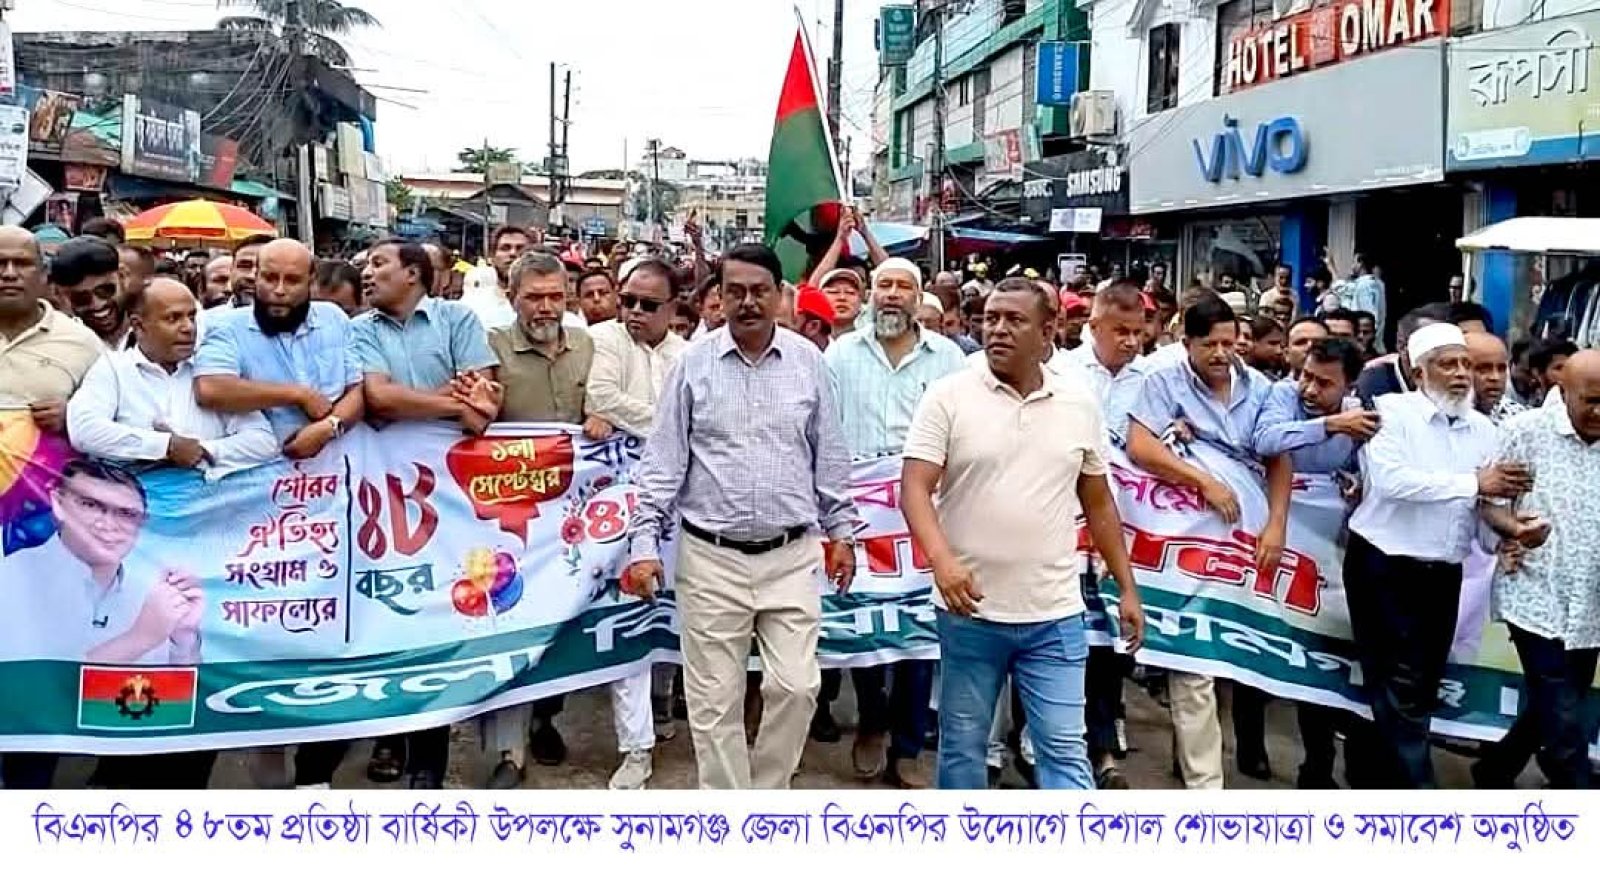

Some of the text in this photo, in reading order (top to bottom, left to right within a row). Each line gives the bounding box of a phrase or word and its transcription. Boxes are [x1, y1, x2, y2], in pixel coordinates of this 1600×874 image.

[1227, 22, 1305, 87] HOTEL
[1340, 0, 1435, 55] OMAR
[1469, 31, 1594, 106] রূপসী
[1067, 166, 1121, 197] SAMSUNG
[491, 439, 536, 463] ১লা
[272, 462, 338, 504] গৌরব
[470, 463, 561, 504] সেপ্টেম্বর
[357, 461, 439, 560] ৪৮
[237, 511, 339, 557] ঐতিহ্য
[225, 559, 339, 589] সংগ্রাম ও
[355, 564, 436, 615] বছর
[222, 597, 339, 633] সাফল্যের
[205, 643, 553, 714] জেলা
